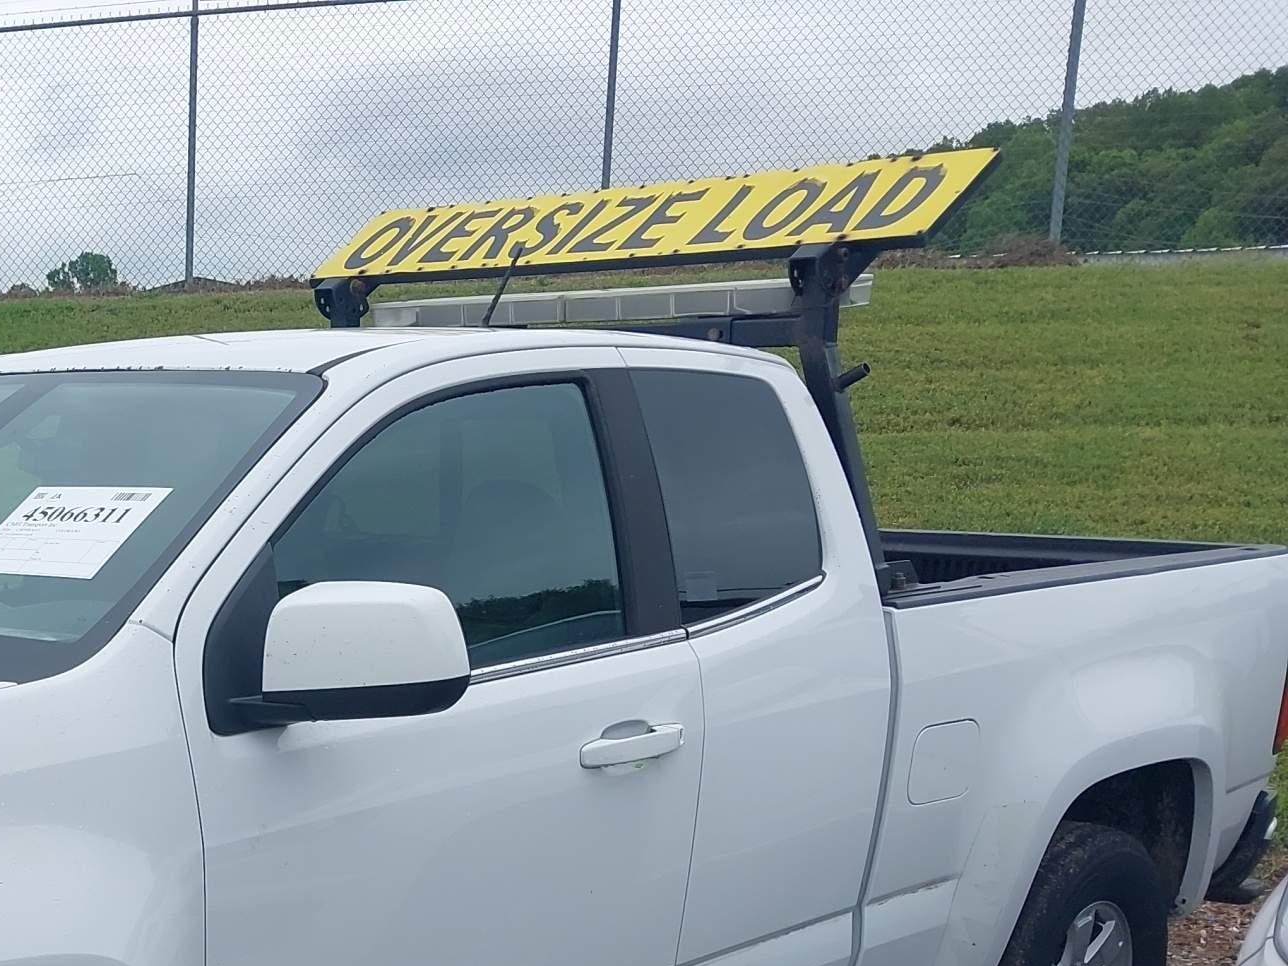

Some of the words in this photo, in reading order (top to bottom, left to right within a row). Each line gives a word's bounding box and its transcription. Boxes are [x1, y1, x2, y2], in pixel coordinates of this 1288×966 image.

[344, 186, 711, 270] OVERSIZE
[687, 163, 948, 243] LOAD
[22, 506, 132, 523] 45066311
